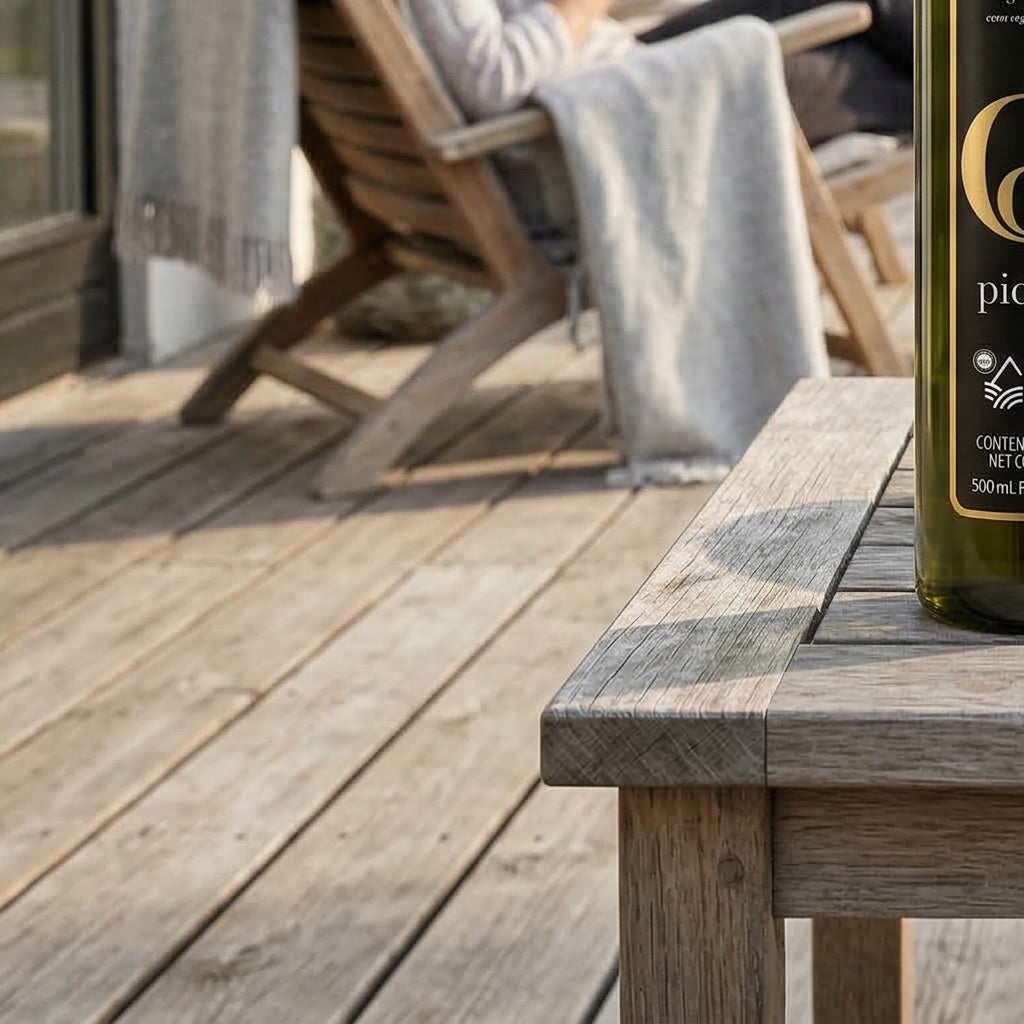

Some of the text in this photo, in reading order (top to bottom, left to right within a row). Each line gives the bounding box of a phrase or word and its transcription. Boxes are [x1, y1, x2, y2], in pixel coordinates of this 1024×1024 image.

[988, 454, 1014, 469] NET
[971, 478, 995, 494] 500
[996, 480, 1017, 495] mL
